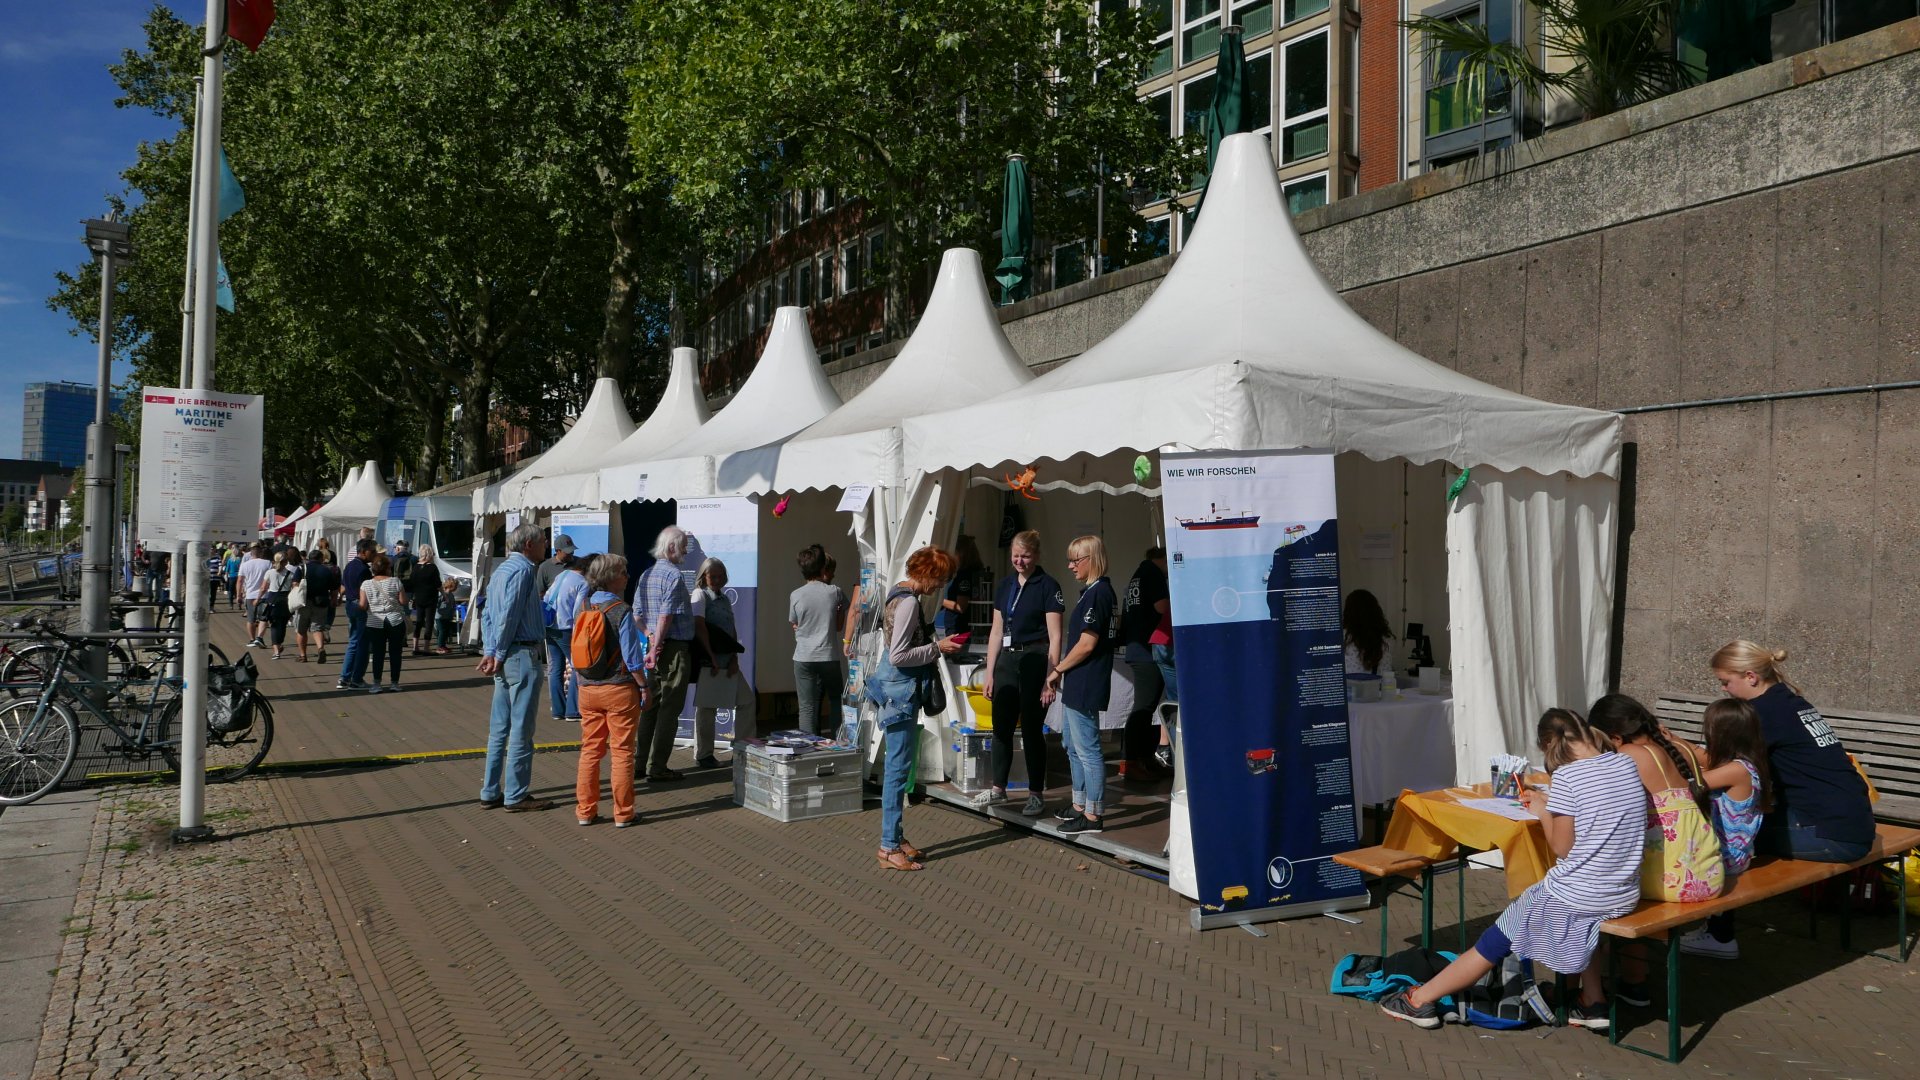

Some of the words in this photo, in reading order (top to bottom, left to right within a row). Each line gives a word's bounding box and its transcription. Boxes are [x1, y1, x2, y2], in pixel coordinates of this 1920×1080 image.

[193, 399, 228, 409] BREMER
[175, 408, 233, 420] MARITIME
[183, 417, 225, 428] WOCHE
[1167, 469, 1185, 477] WIE
[1187, 468, 1205, 477] WIR
[1207, 466, 1256, 476] FORSCHEN
